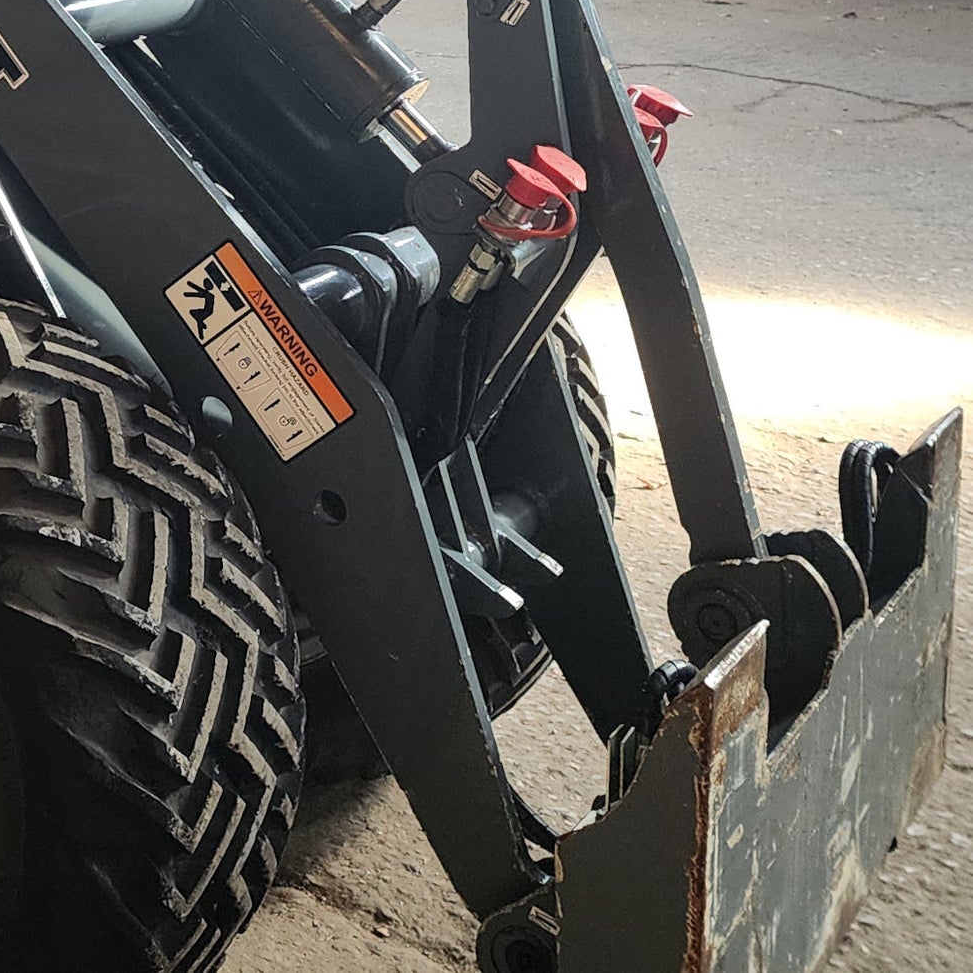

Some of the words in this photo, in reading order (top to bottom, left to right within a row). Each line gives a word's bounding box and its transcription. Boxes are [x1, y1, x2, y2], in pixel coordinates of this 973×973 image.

[258, 299, 319, 379] WARNING
[270, 346, 290, 370] CRUSH
[287, 368, 309, 396] HAZARD
